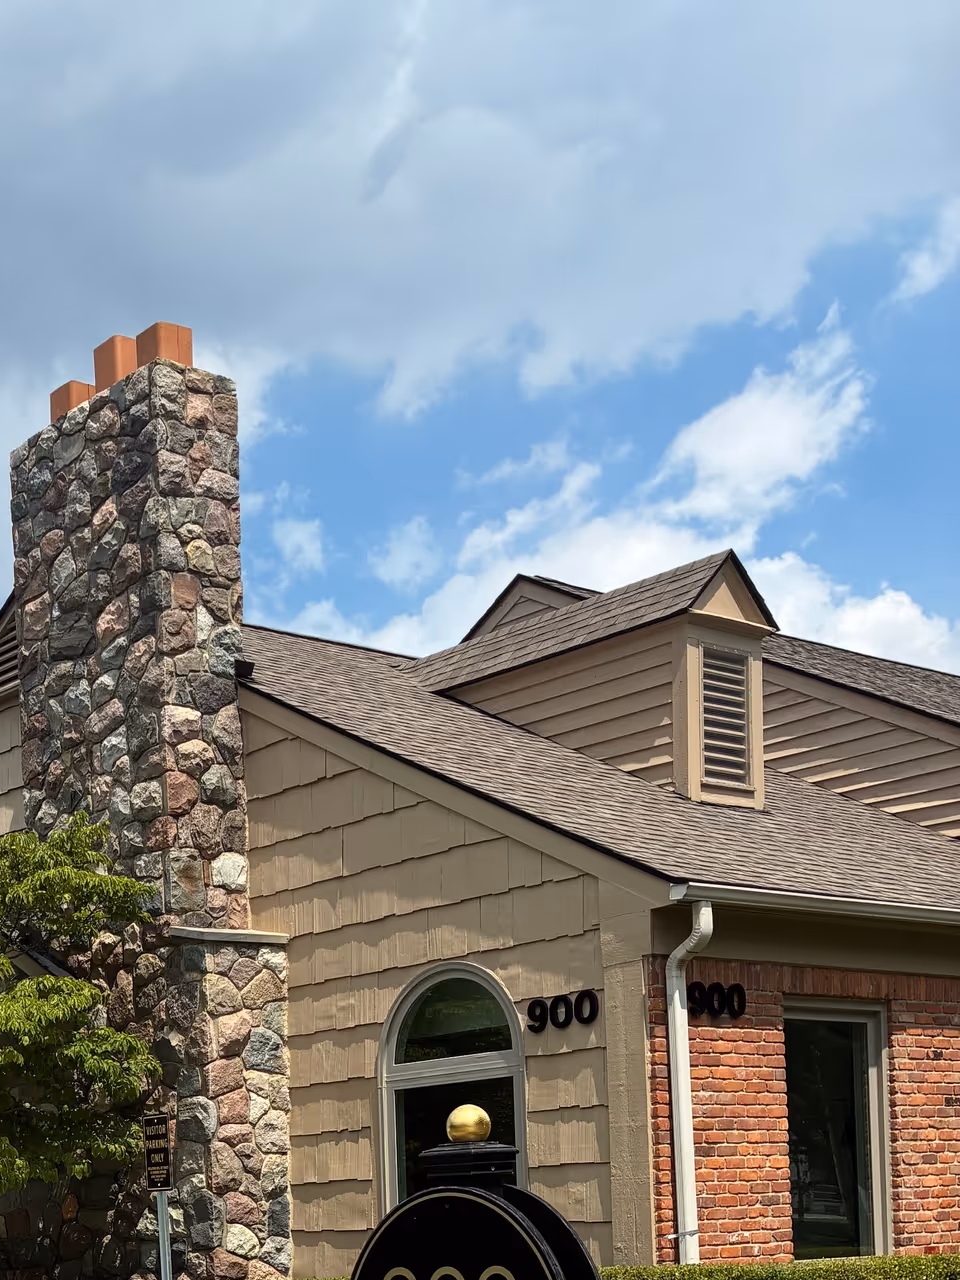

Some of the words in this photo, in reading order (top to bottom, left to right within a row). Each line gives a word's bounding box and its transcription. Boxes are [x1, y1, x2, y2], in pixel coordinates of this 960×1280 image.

[687, 980, 747, 1019] 900
[527, 989, 599, 1034] 900
[145, 1125, 166, 1135] VISITOR
[145, 1139, 168, 1149] PARKING
[150, 1153, 164, 1163] ONLY
